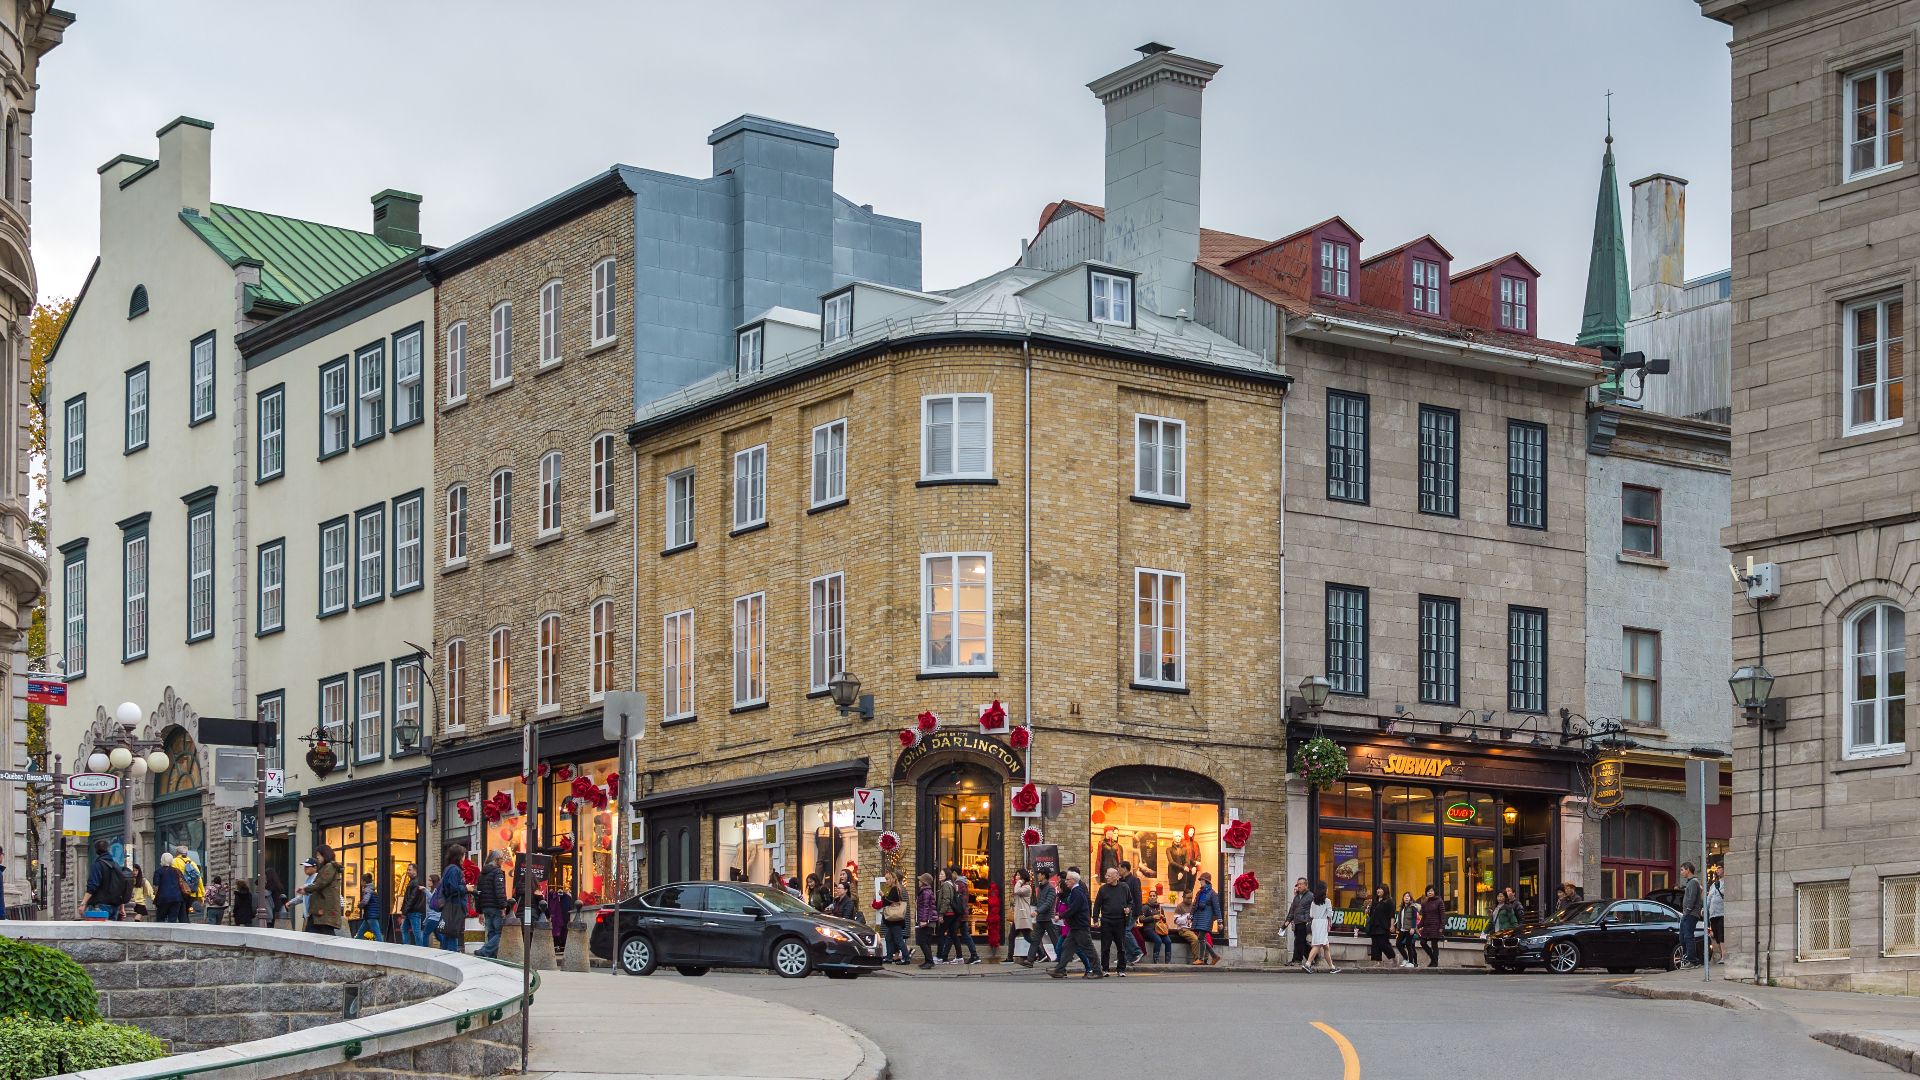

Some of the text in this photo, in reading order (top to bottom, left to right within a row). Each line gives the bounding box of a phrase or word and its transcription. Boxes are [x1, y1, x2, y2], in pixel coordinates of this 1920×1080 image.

[902, 736, 1020, 773] JOHN DARLINGTON
[1383, 754, 1452, 777] SUBWAY
[1332, 911, 1367, 926] UBWAY
[1445, 916, 1489, 931] SUBWAY
